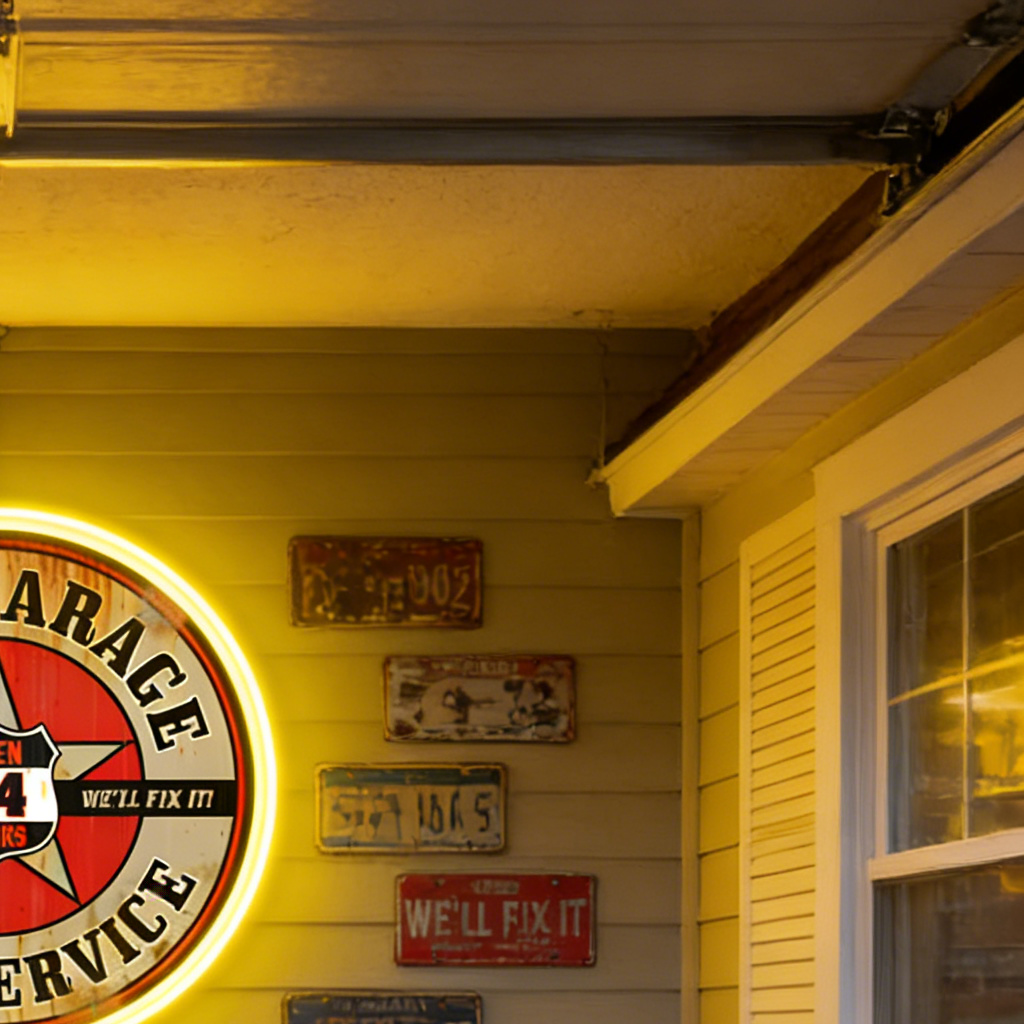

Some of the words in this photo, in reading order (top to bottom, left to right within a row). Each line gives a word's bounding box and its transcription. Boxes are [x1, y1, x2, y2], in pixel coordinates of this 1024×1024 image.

[82, 789, 140, 809] WE'LL
[145, 789, 182, 809] FIX
[405, 896, 492, 939] WE'LL
[503, 899, 551, 939] FIX
[559, 898, 587, 938] IT
